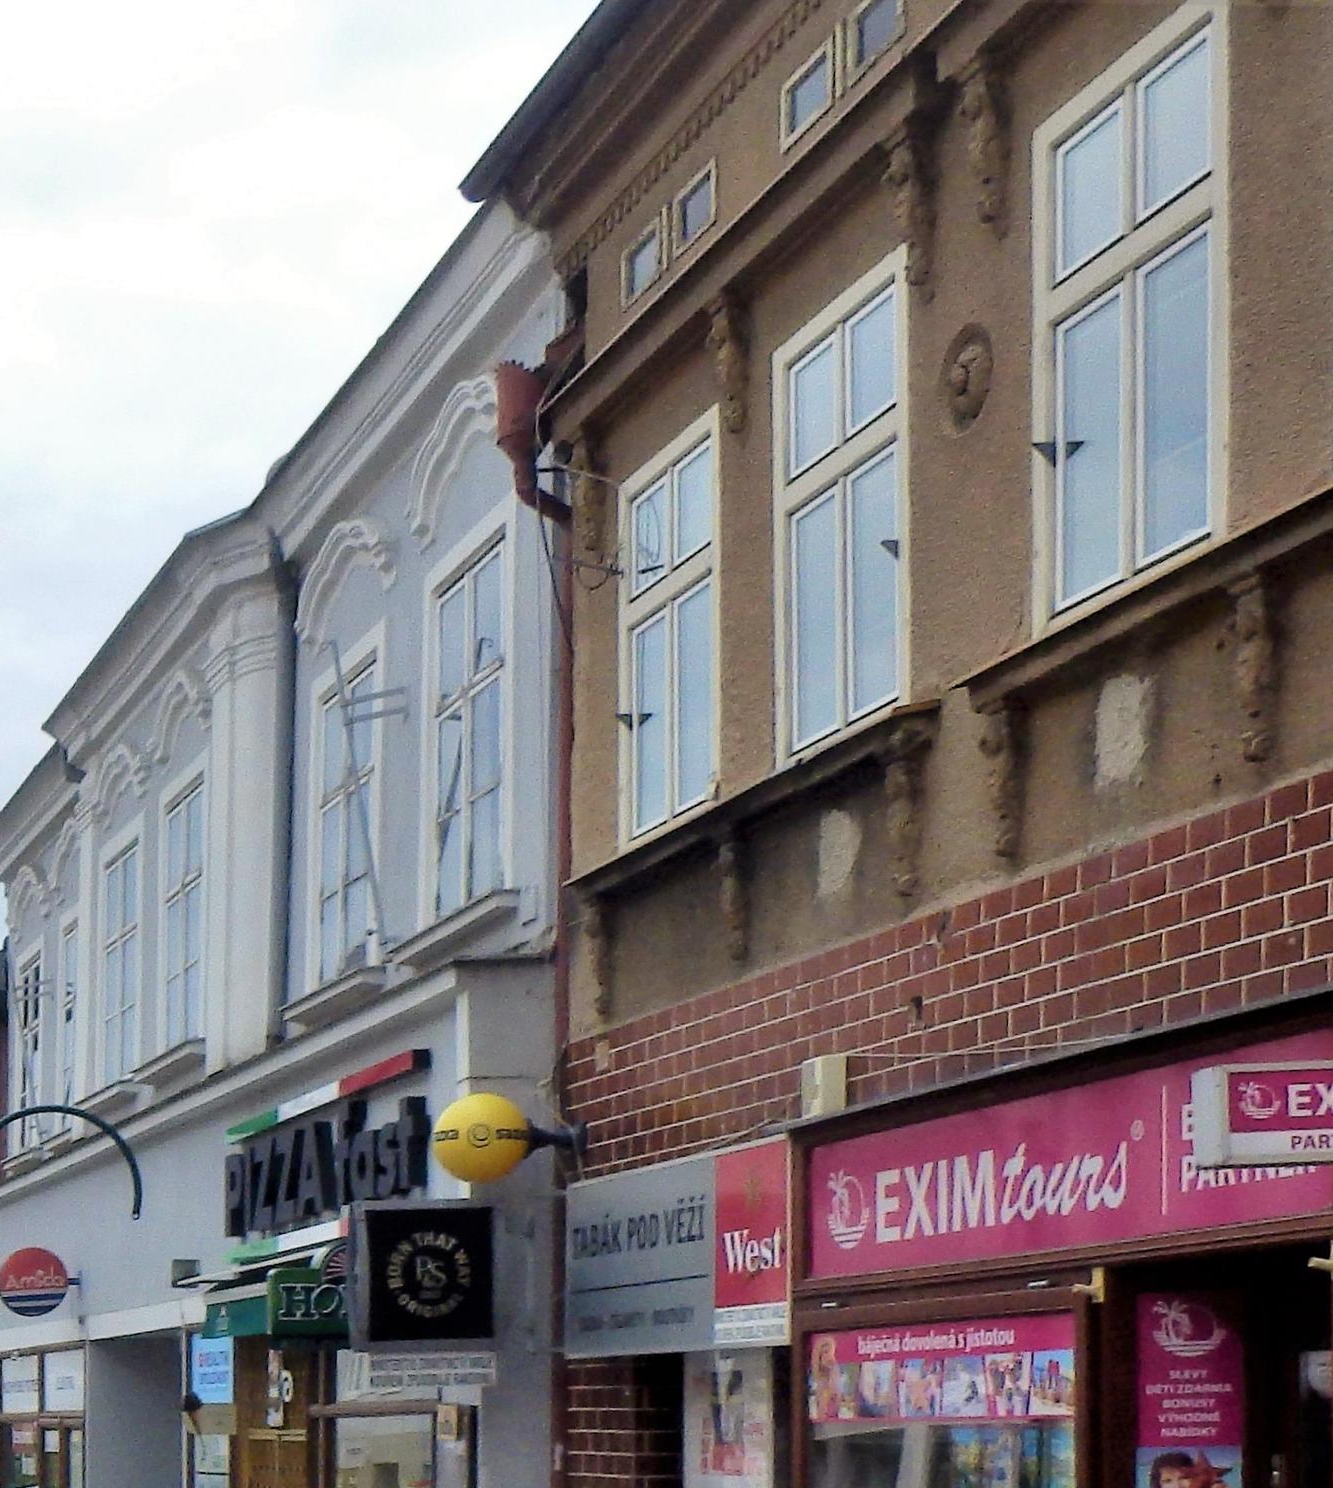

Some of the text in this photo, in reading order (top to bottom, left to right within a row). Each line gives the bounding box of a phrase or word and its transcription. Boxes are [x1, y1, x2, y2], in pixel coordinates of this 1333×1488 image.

[224, 1095, 431, 1238] PIZZA fast
[874, 1141, 1129, 1244] EXIMtours
[412, 1231, 460, 1251] THAT
[572, 1194, 706, 1260] TABÁK POD VĚŽÍ
[723, 1226, 782, 1275] West
[277, 1283, 347, 1321] HO
[902, 1329, 956, 1351] dovolená
[957, 1332, 965, 1349] s
[965, 1328, 1015, 1352] jistotou
[1169, 1369, 1208, 1380] SLEVY
